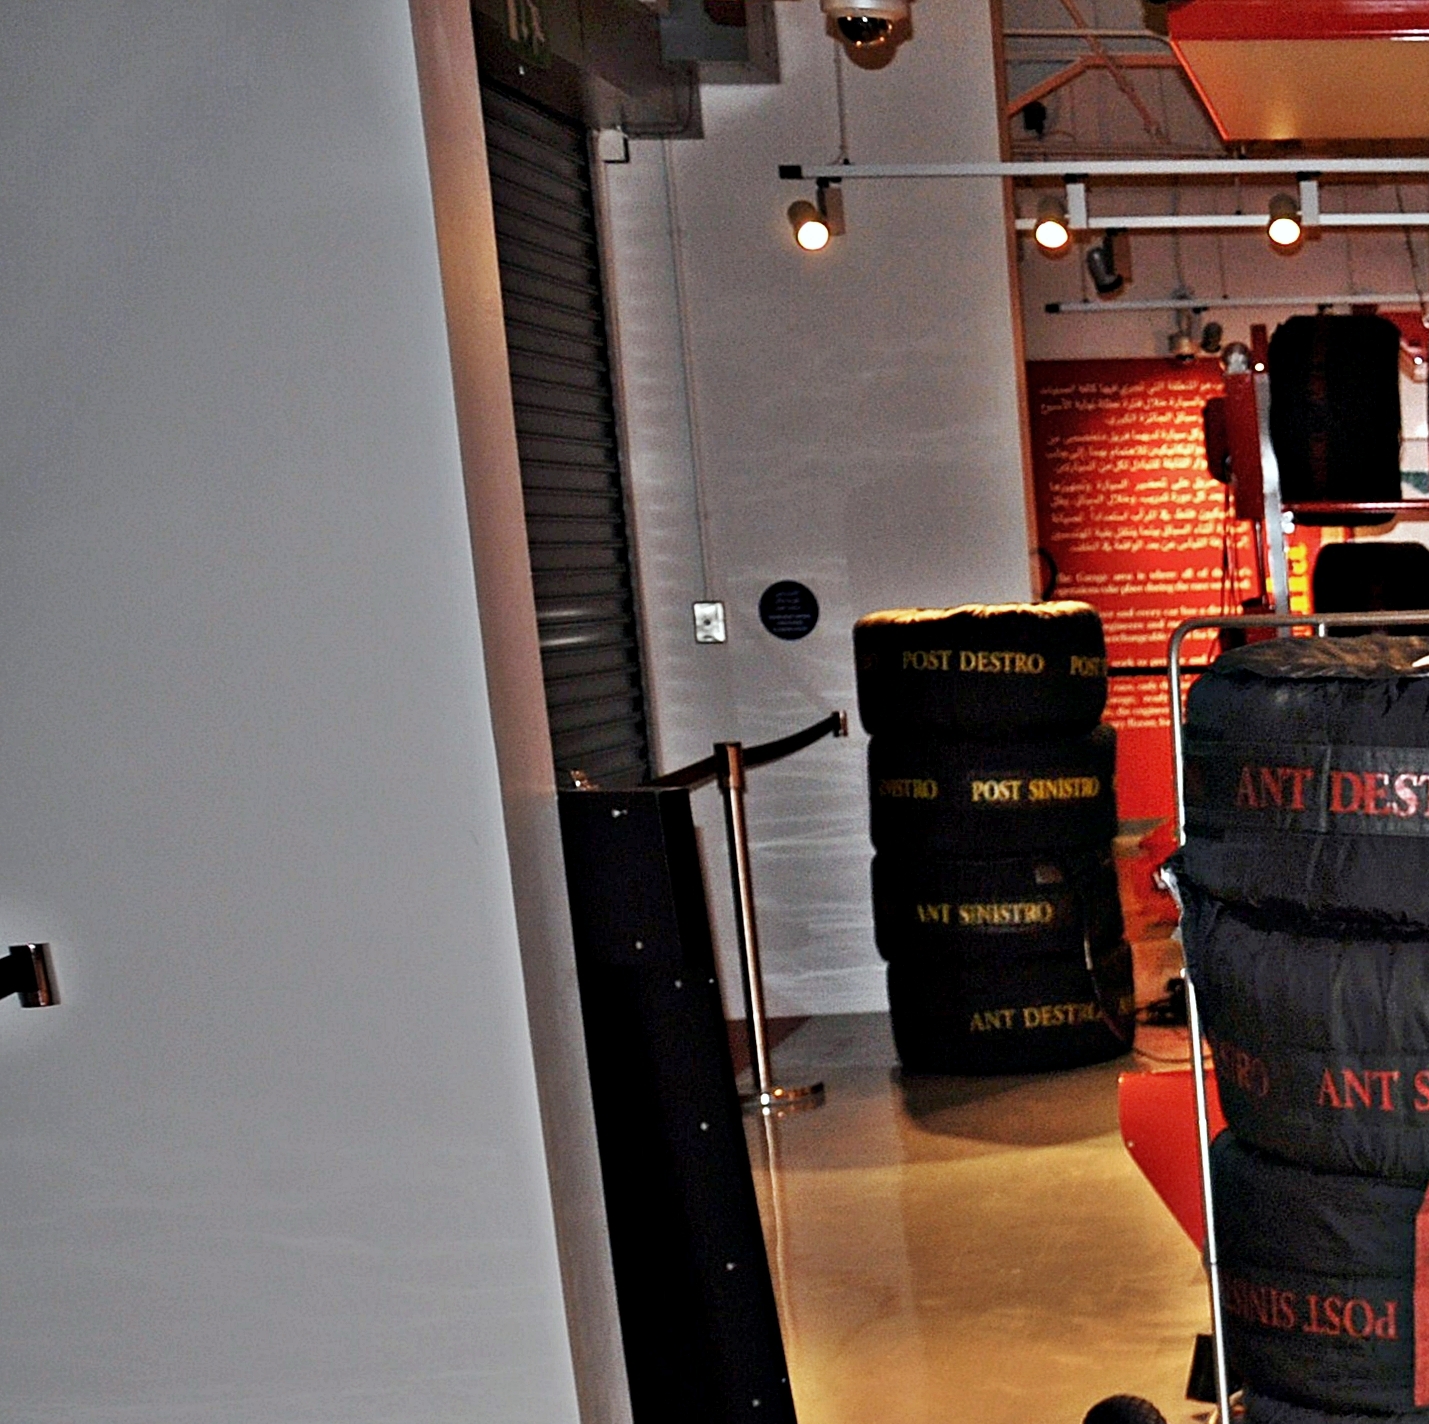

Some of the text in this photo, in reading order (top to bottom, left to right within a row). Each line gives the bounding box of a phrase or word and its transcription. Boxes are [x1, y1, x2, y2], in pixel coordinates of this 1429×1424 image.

[902, 650, 952, 671] POST
[958, 650, 1047, 675] DESTRO
[971, 776, 1100, 802] POST SINISTRO
[1235, 766, 1315, 811] ANT
[958, 902, 1055, 926] SINISTRO
[970, 1008, 1016, 1032] ANT
[1318, 1068, 1399, 1112] ANT
[1302, 1297, 1397, 1340] POST
